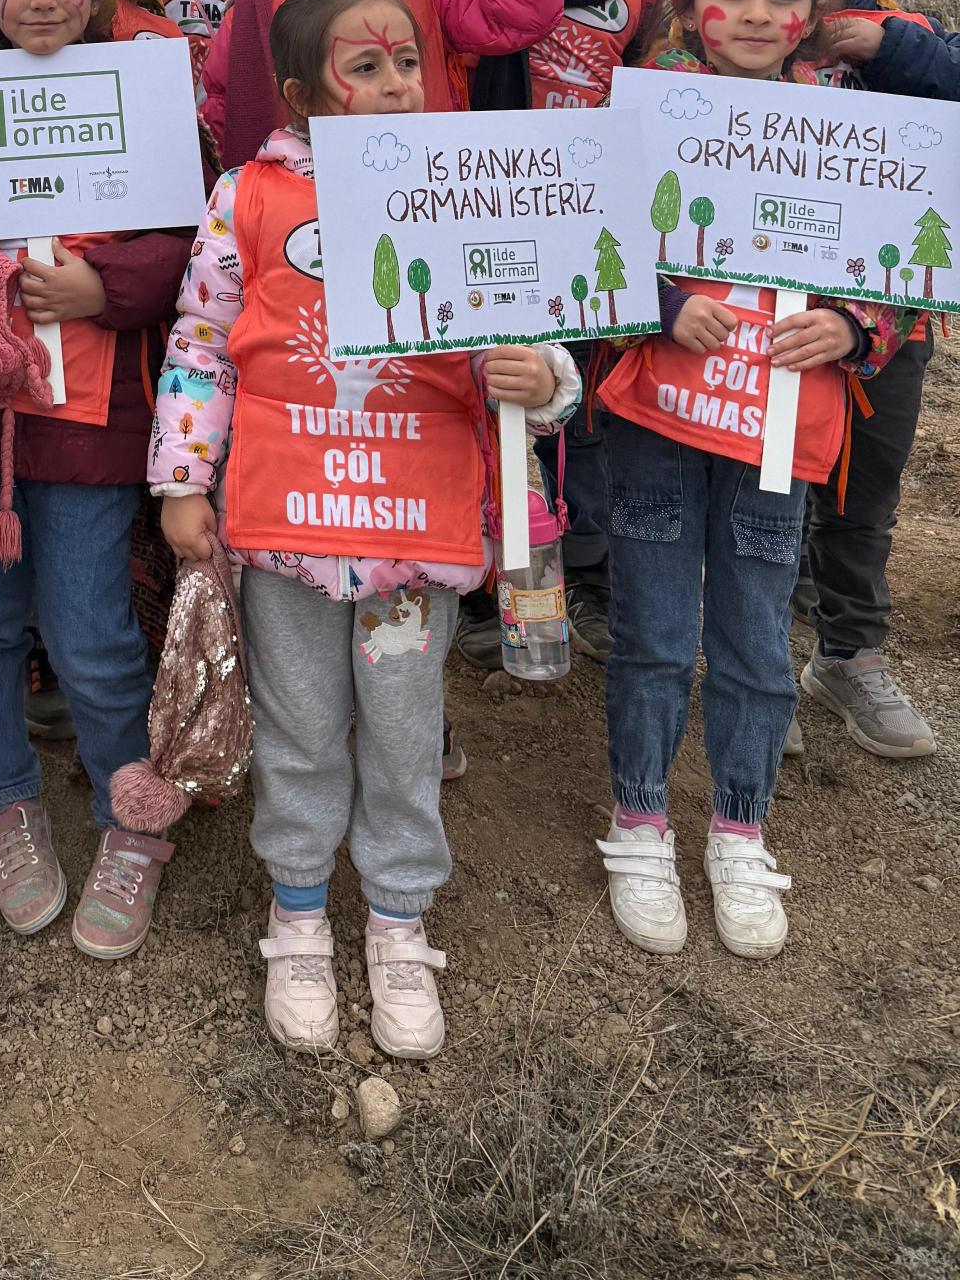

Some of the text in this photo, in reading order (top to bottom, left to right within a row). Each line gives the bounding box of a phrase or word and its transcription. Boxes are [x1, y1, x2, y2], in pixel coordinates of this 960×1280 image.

[10, 87, 67, 115] ilde
[12, 120, 114, 147] orman
[727, 105, 886, 155] İŞ BANKASI
[426, 146, 562, 186] İŞ BANKASI
[677, 136, 933, 196] ORMANI İSTERİZ.
[9, 176, 53, 195] TEMA
[386, 177, 604, 223] ORMANI İSTERİZ.
[759, 199, 816, 227] 81 ilde
[787, 218, 836, 235] orman
[782, 241, 803, 252] TEMA
[469, 248, 516, 279] 81 ilde
[494, 264, 535, 279] orman
[494, 292, 512, 302] TEMA
[188, 368, 216, 380] Dream
[702, 354, 761, 396] ÇÖL
[657, 383, 764, 441] OLMAS
[324, 442, 387, 489] ÇÖL
[285, 490, 427, 532] OLMASIN
